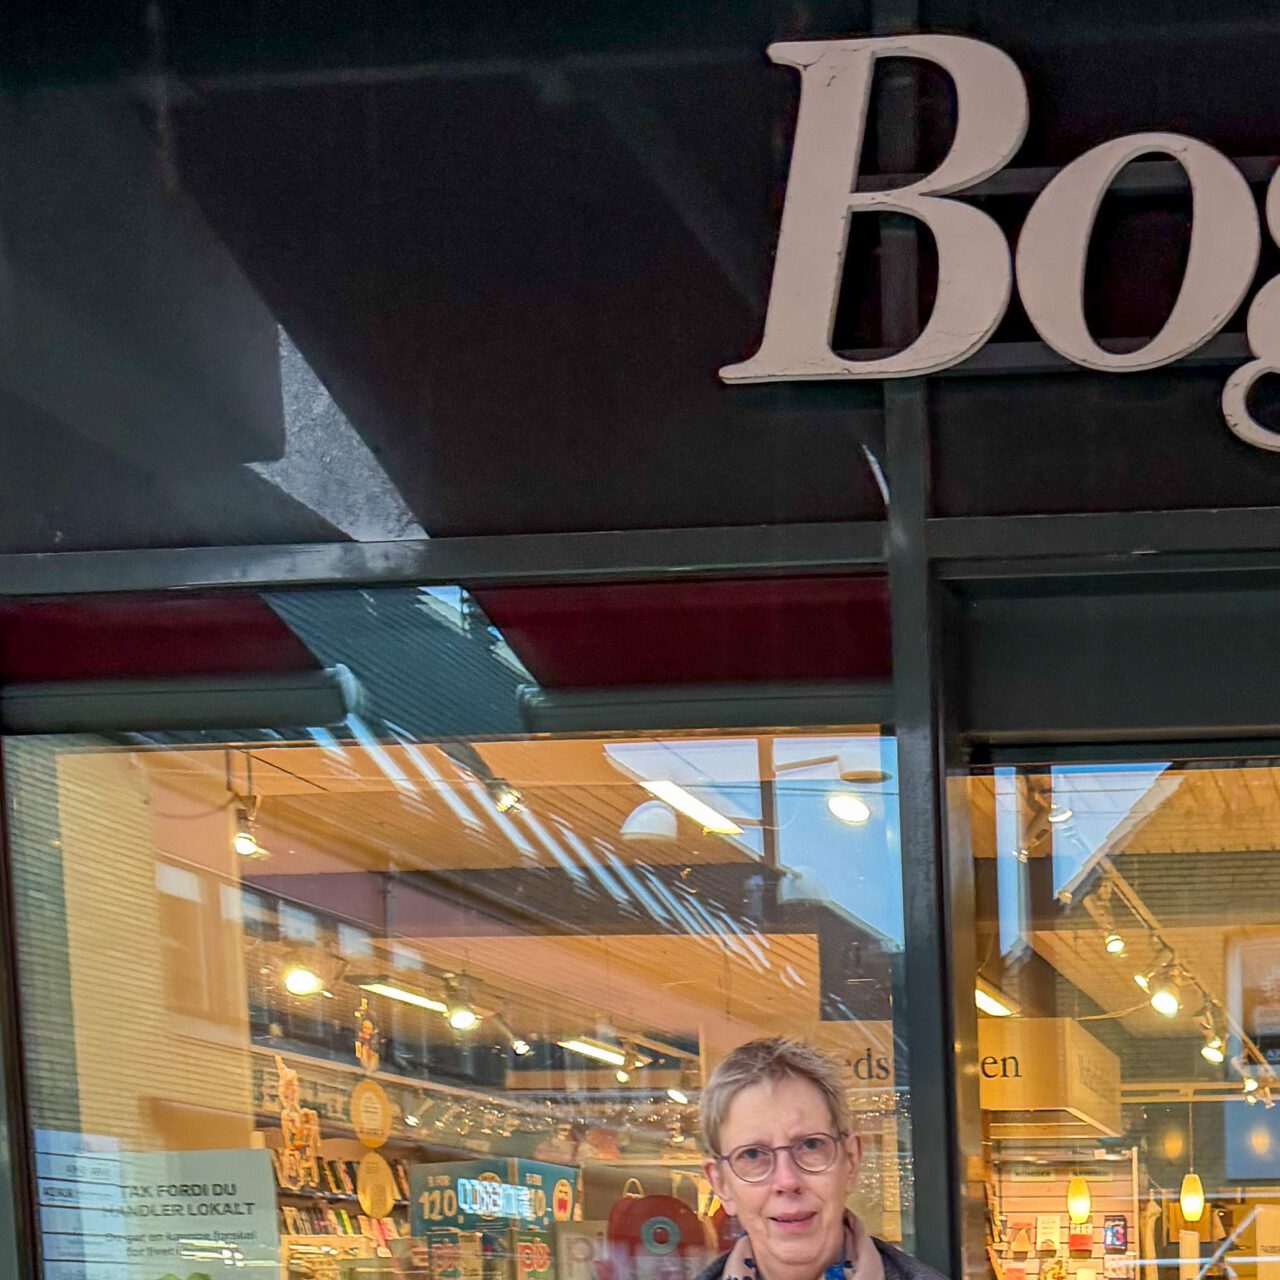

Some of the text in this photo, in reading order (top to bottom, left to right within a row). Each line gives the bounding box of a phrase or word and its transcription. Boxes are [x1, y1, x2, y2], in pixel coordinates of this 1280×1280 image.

[847, 1047, 891, 1080] ds
[157, 1184, 208, 1197] FORDI
[212, 1183, 237, 1196] DU
[187, 1202, 255, 1217] LOKALT
